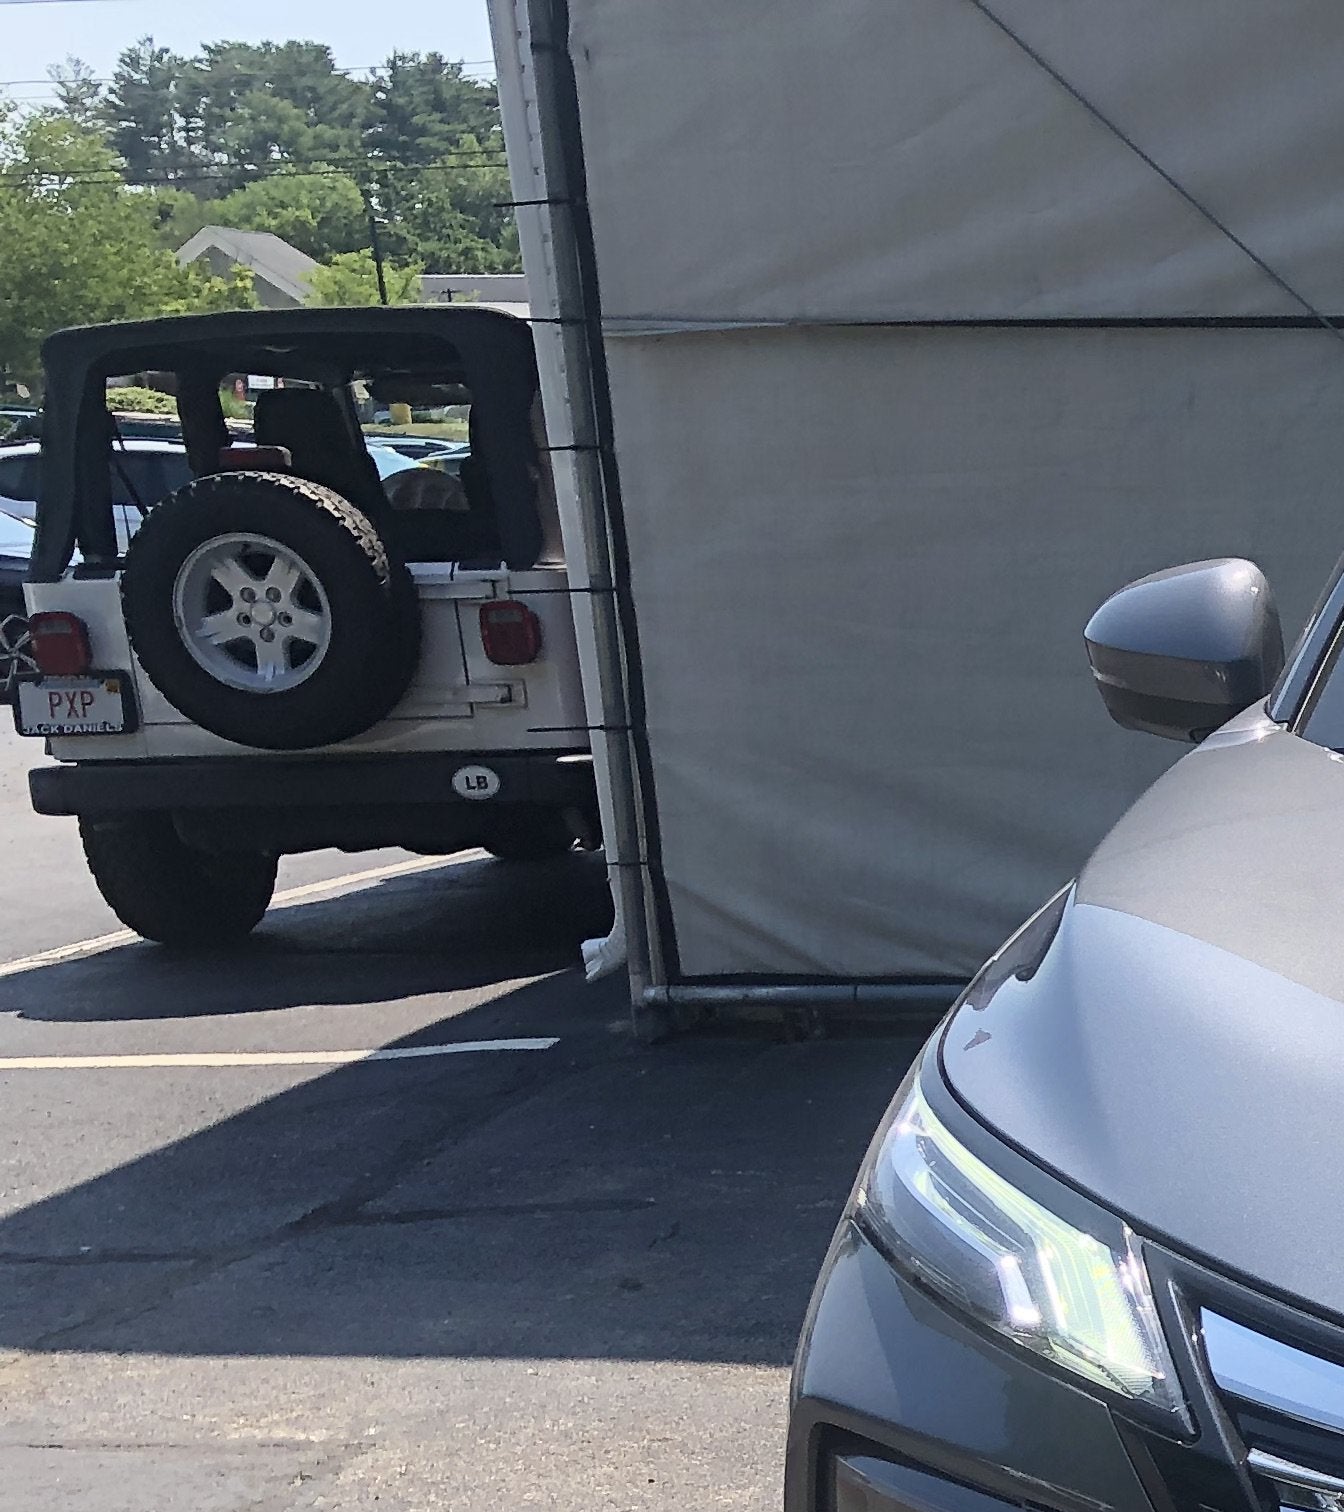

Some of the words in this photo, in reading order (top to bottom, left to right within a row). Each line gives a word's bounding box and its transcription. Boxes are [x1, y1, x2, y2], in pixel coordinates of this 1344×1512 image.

[48, 690, 95, 719] PXP
[23, 724, 60, 735] JACK
[465, 775, 489, 790] LB
